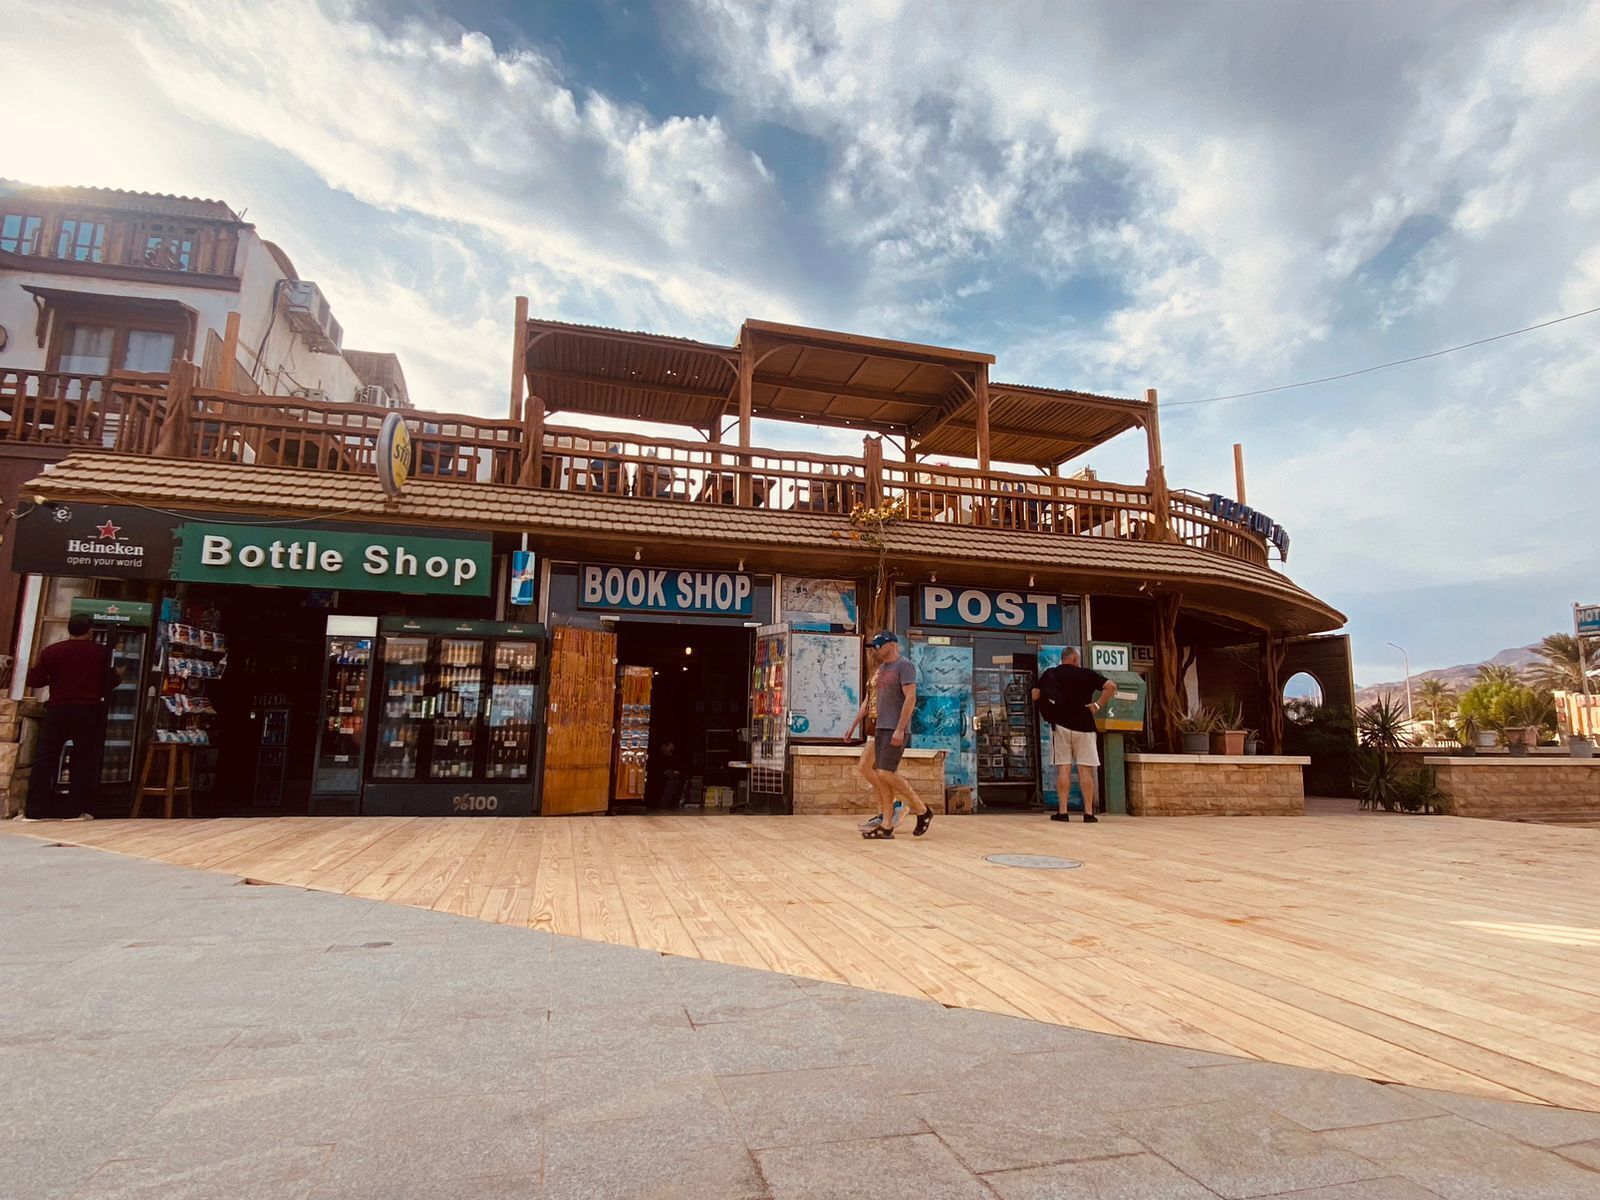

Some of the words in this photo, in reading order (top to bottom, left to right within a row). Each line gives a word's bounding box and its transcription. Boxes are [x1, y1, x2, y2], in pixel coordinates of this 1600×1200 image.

[66, 556, 91, 565] open
[93, 558, 115, 567] your
[116, 559, 143, 568] world
[67, 540, 144, 556] Heineken
[201, 534, 344, 572] Bottle
[362, 544, 477, 586] Shop
[584, 566, 668, 607] BOOK
[676, 571, 751, 611] SHOP
[924, 586, 1057, 628] POST
[1096, 650, 1125, 666] POST
